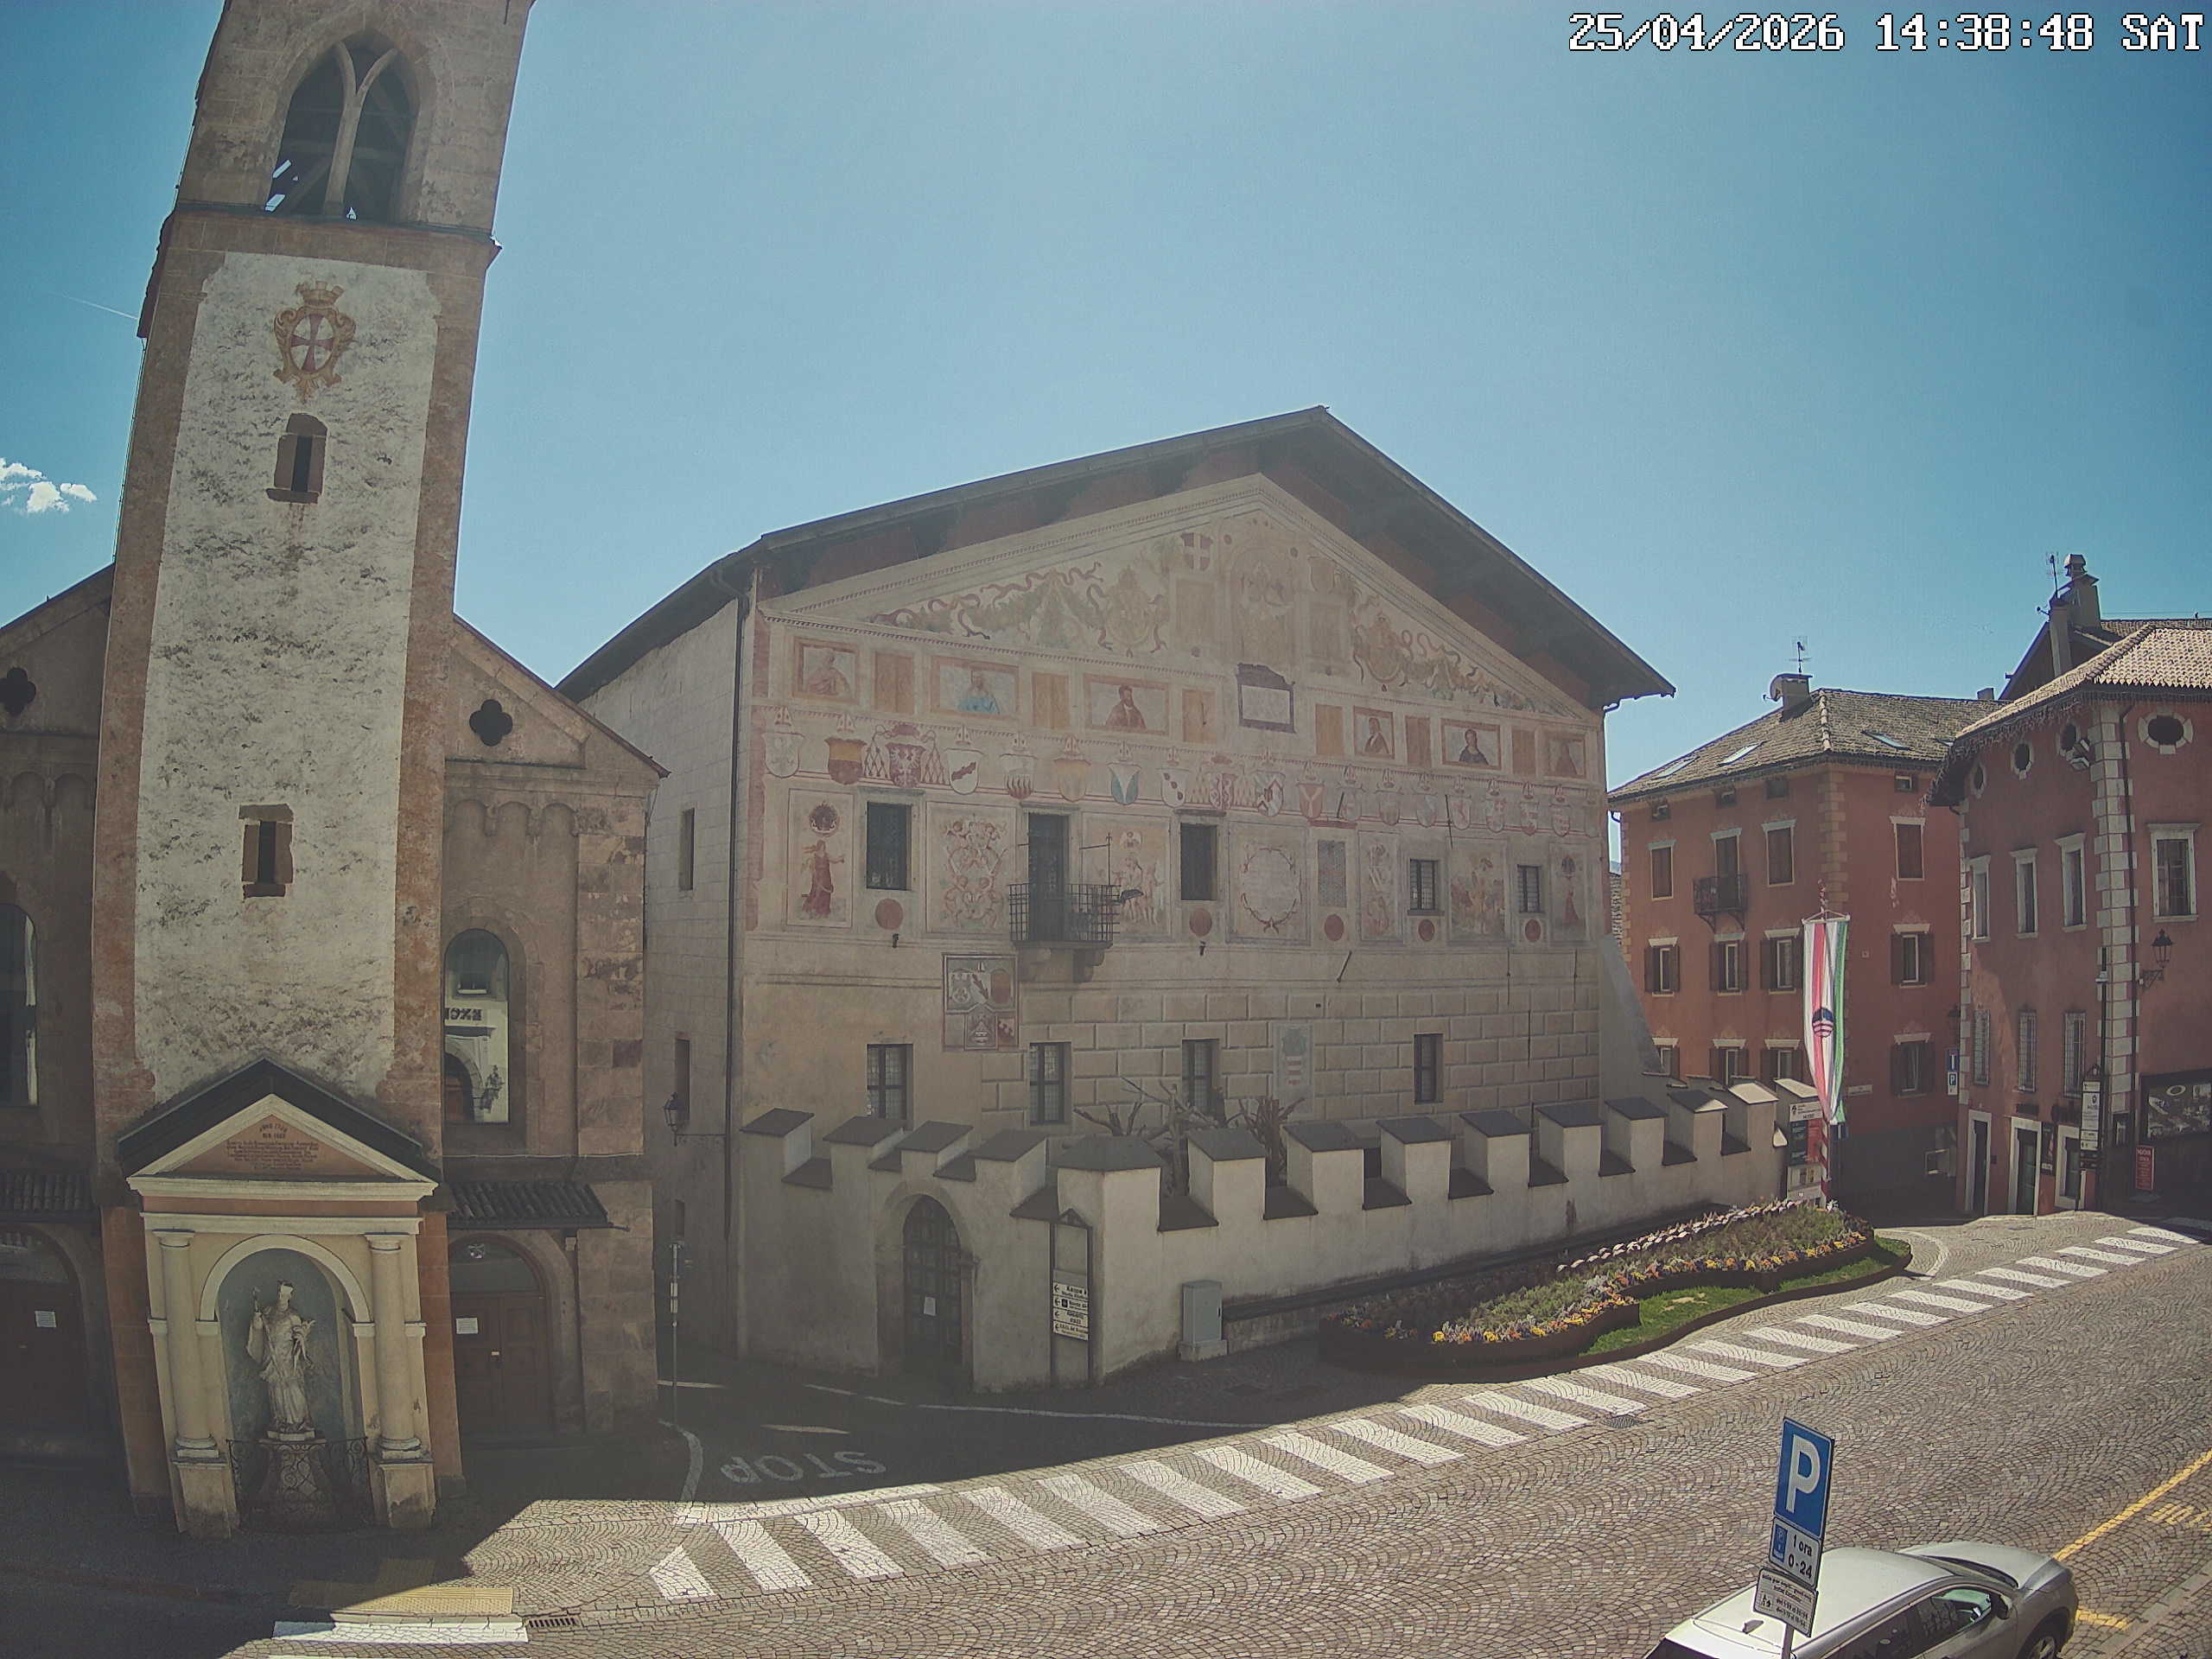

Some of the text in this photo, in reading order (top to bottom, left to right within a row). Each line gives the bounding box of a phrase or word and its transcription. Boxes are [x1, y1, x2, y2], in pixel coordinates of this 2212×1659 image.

[720, 1452, 887, 1484] STOP
[1785, 1433, 1821, 1513] P
[1793, 1534, 1813, 1557] 1 ora
[1789, 1554, 1813, 1580] 0-24
